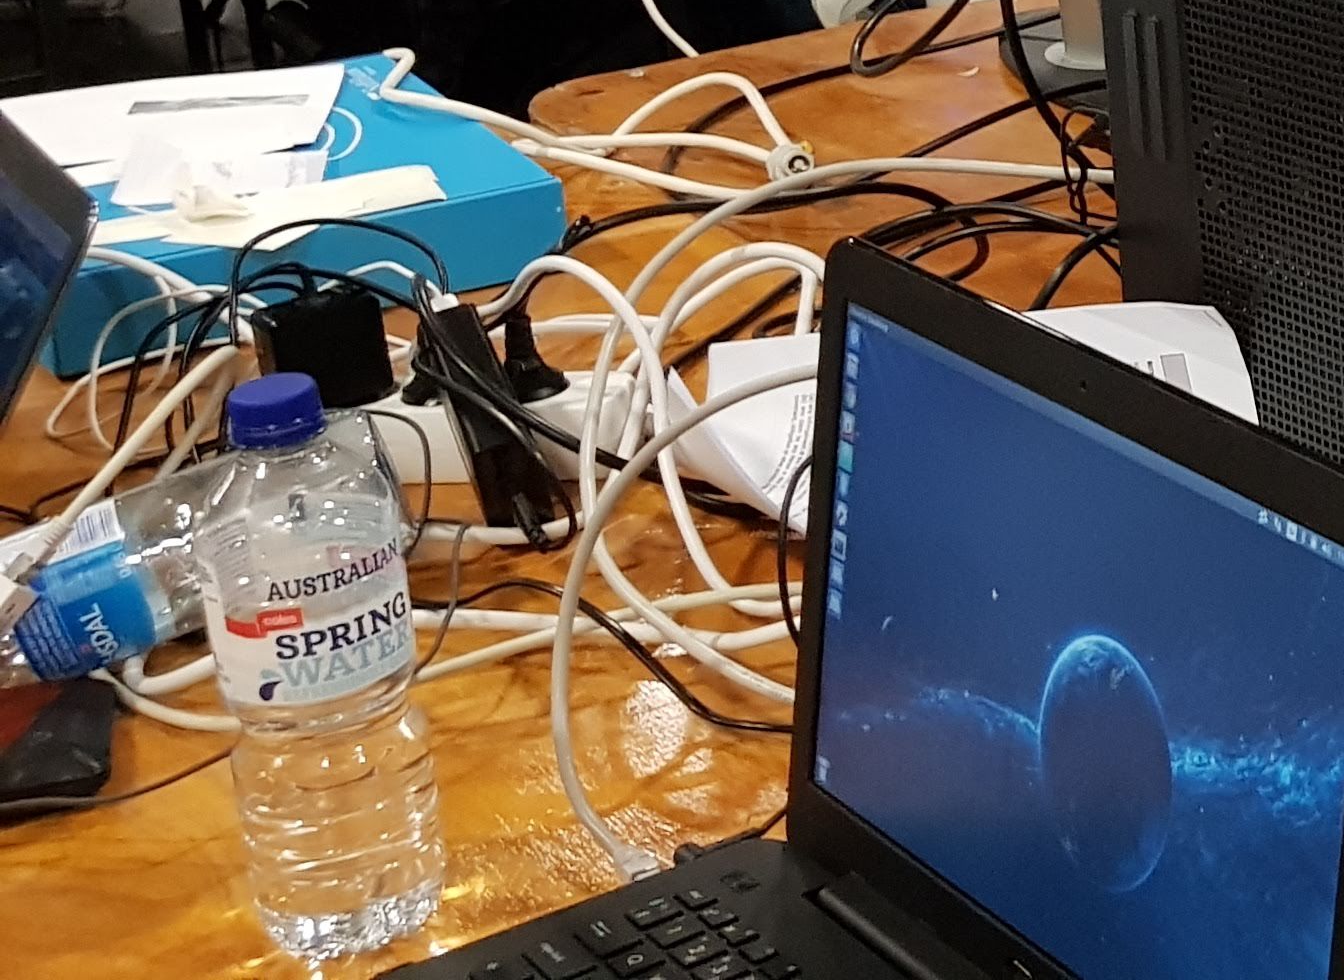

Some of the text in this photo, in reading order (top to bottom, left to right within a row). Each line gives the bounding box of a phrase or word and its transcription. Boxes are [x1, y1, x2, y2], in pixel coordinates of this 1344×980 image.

[267, 538, 399, 602] AUSTRALIAN
[275, 591, 407, 661] SPRING
[278, 620, 409, 688] WATER
